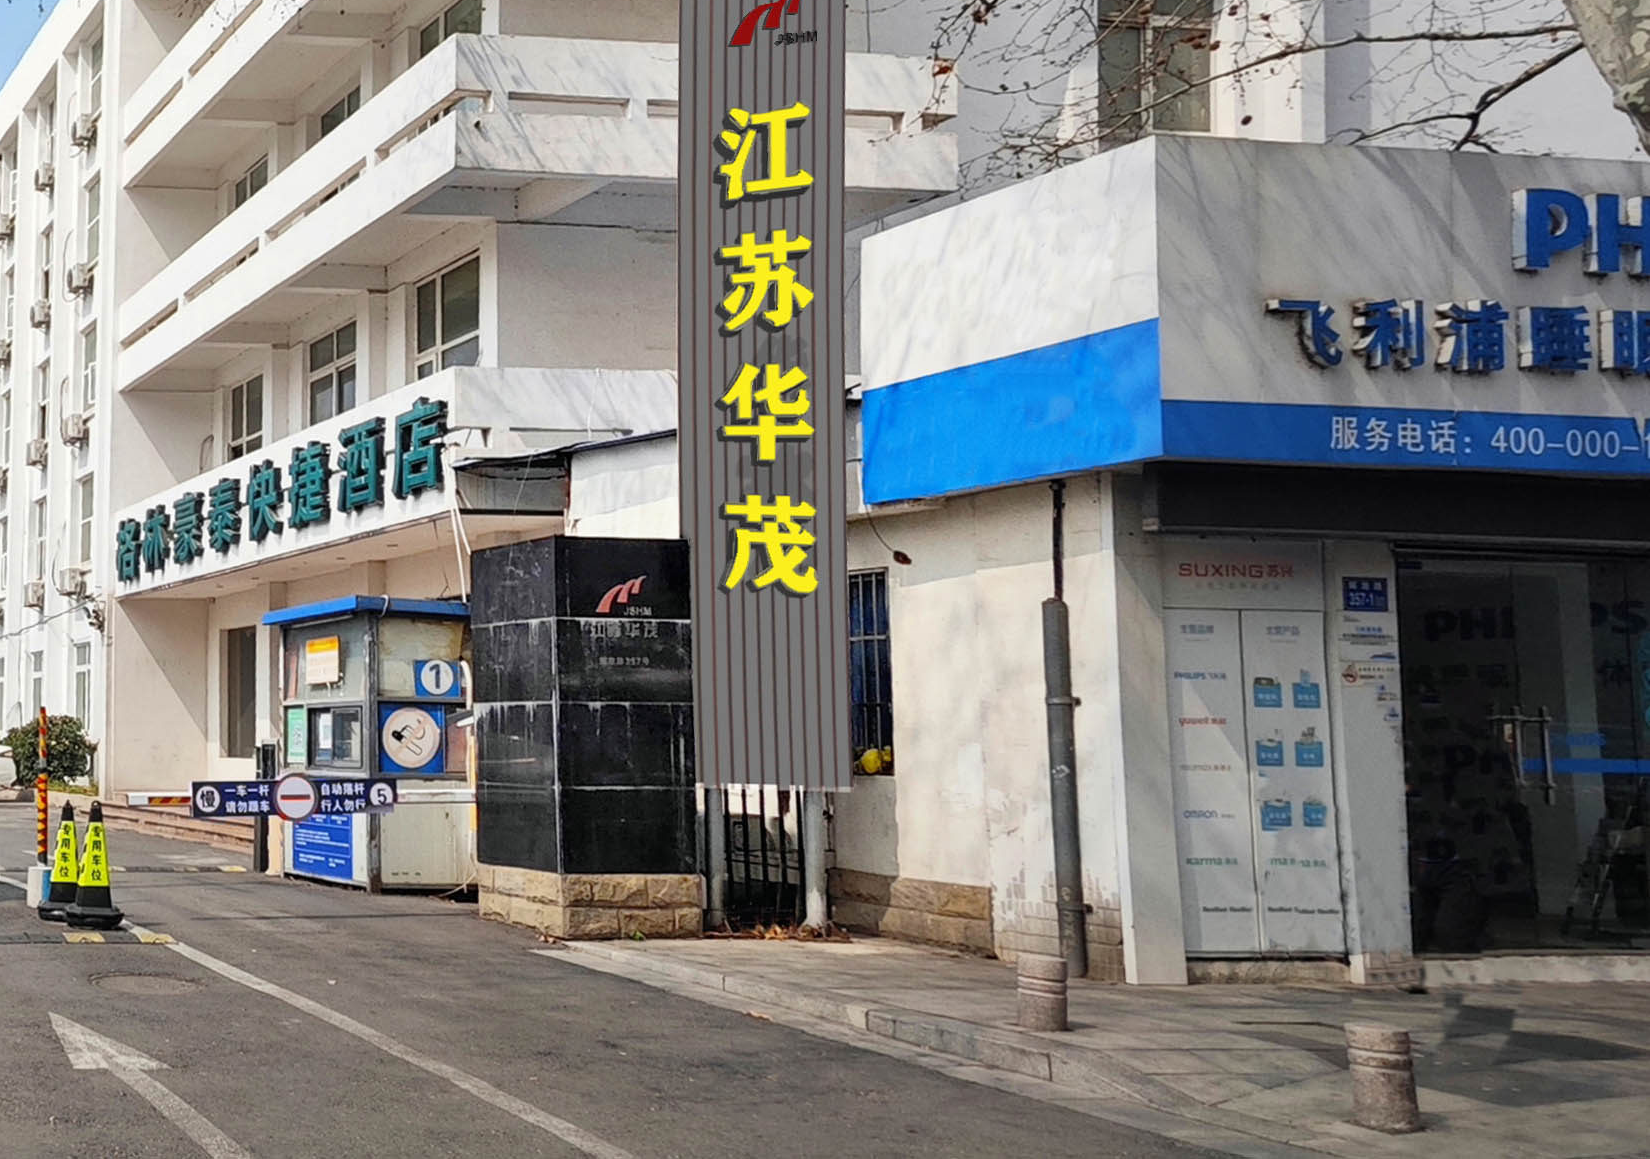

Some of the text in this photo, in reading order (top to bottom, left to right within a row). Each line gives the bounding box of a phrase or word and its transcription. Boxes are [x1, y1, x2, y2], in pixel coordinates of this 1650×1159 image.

[716, 102, 818, 595] 江苏华茂
[116, 396, 449, 582] 格林豪泰快捷酒店
[429, 663, 441, 690] 1
[224, 784, 270, 796] 一车一杆
[377, 787, 387, 805] 5
[225, 800, 270, 813] 请勿跟车
[321, 799, 366, 812] 行人勿行
[58, 823, 71, 878] 专用车位
[90, 825, 102, 882] 专用车位
